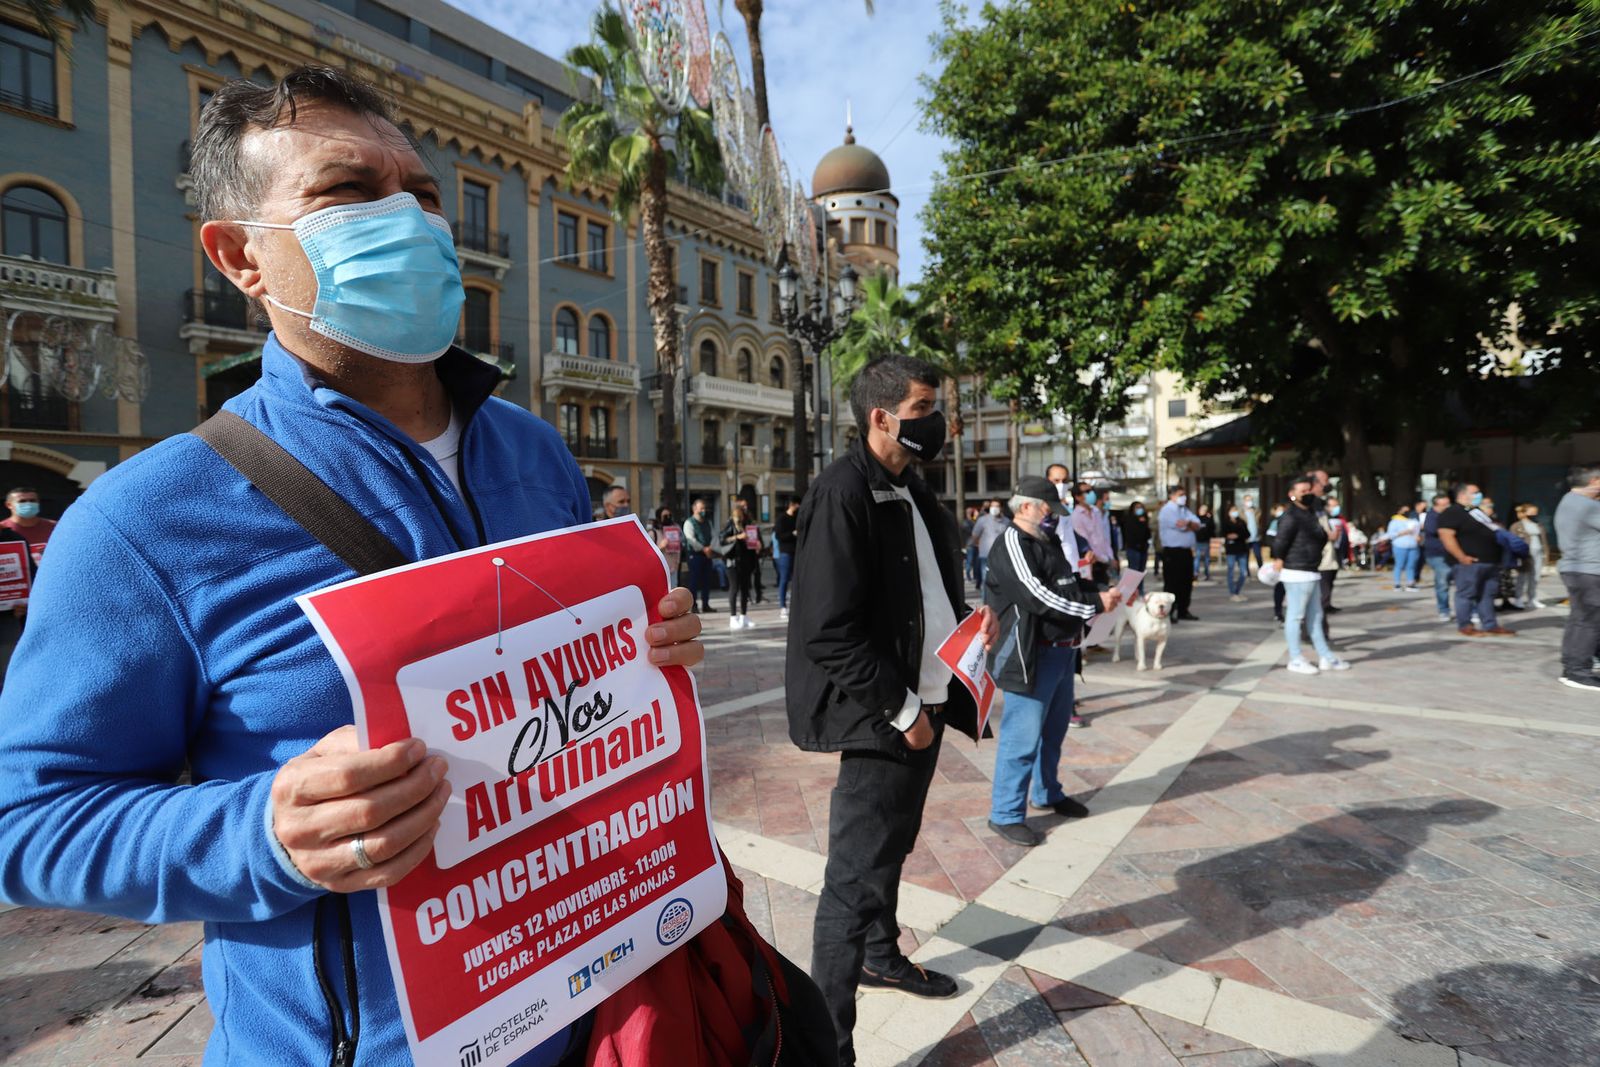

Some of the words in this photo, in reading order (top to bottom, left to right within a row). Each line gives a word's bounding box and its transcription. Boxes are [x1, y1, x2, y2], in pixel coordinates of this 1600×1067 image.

[445, 671, 517, 742] SIN
[522, 617, 637, 710] AYUDAS
[508, 679, 613, 777] Nos
[465, 699, 666, 842] Arruinan!
[415, 777, 695, 946] CONCENTRACIÓN
[463, 924, 524, 973] JUEVES
[524, 913, 545, 937] 12
[545, 867, 628, 926] NOVIEMBRE
[635, 840, 677, 875] 11:00H
[661, 910, 690, 933] HORECA
[478, 949, 534, 993] LUGAR:
[536, 921, 581, 958] PLAZA
[583, 908, 602, 931] DE
[603, 893, 627, 919] LAS
[629, 865, 676, 903] MONJAS
[483, 998, 548, 1045] HOSTELERÍA
[485, 1041, 500, 1058] DE
[503, 1014, 544, 1046] ESPAÑA
